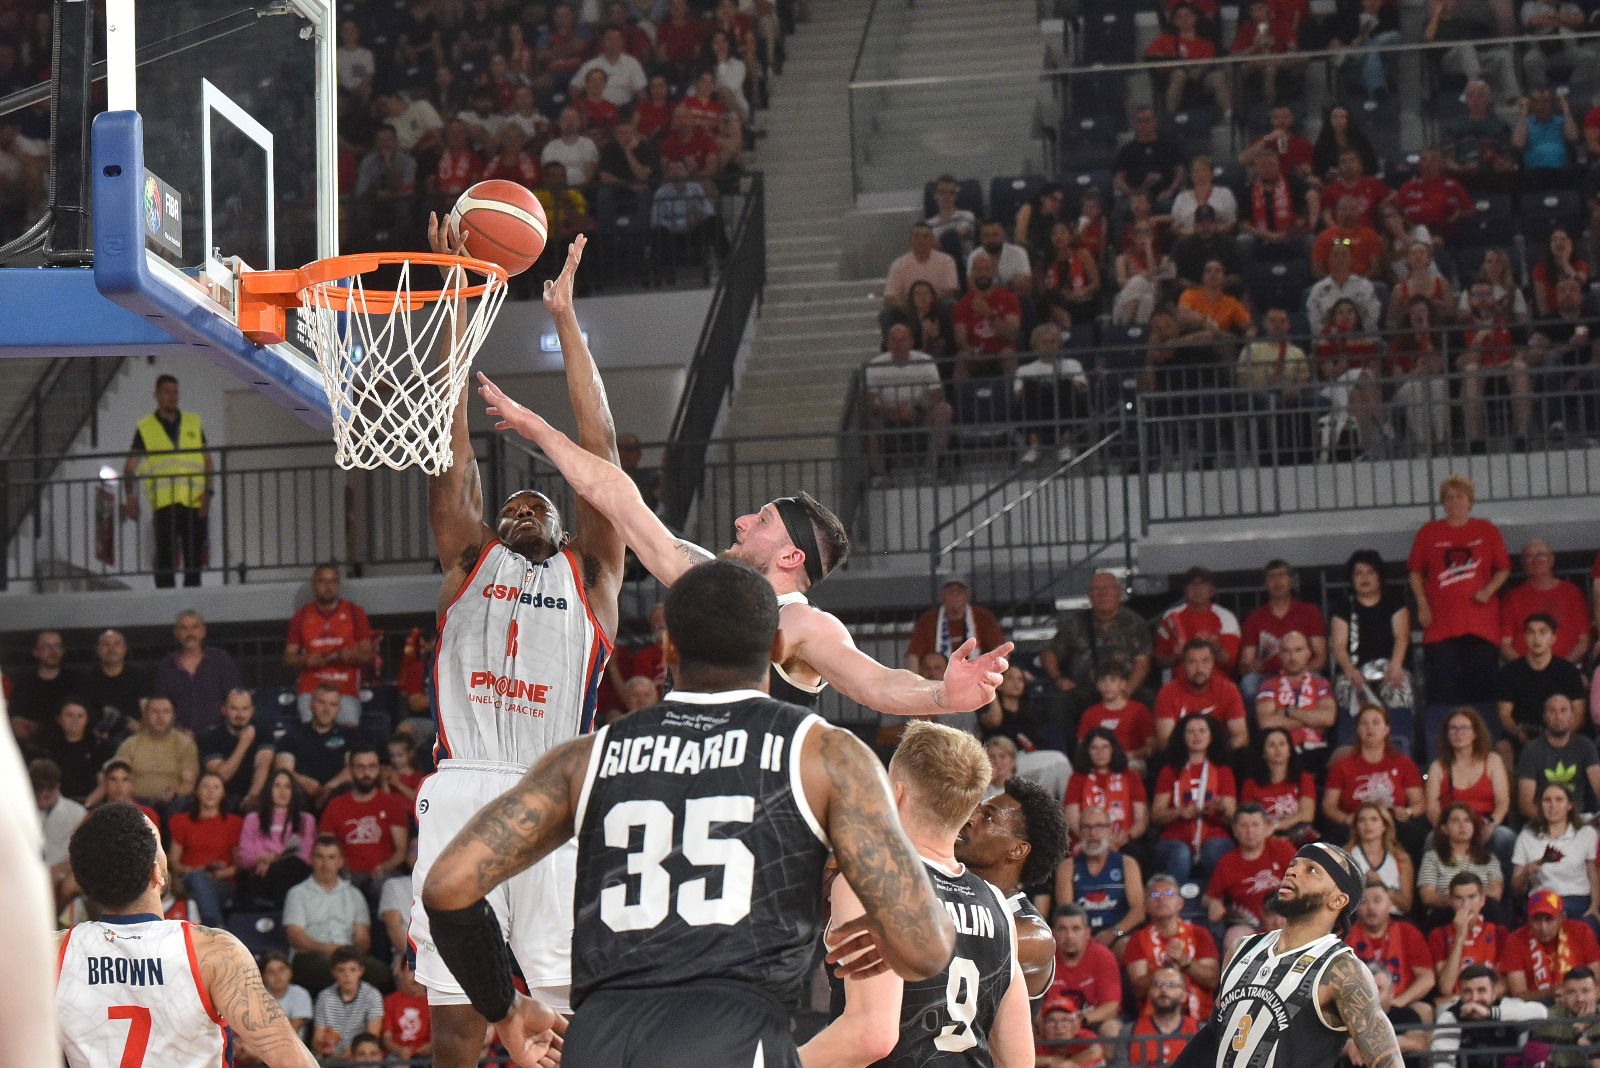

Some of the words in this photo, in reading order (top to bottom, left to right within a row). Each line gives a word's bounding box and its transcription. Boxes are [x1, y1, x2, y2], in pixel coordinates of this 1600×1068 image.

[519, 592, 568, 611] adea
[599, 729, 749, 779] RICHARD
[760, 732, 785, 772] II
[600, 795, 755, 933] 35
[937, 897, 995, 939] ALIN
[87, 956, 164, 986] BROWN
[933, 956, 980, 1053] 9
[1246, 986, 1290, 1032] TRANSILVANIA
[107, 1005, 152, 1068] 7
